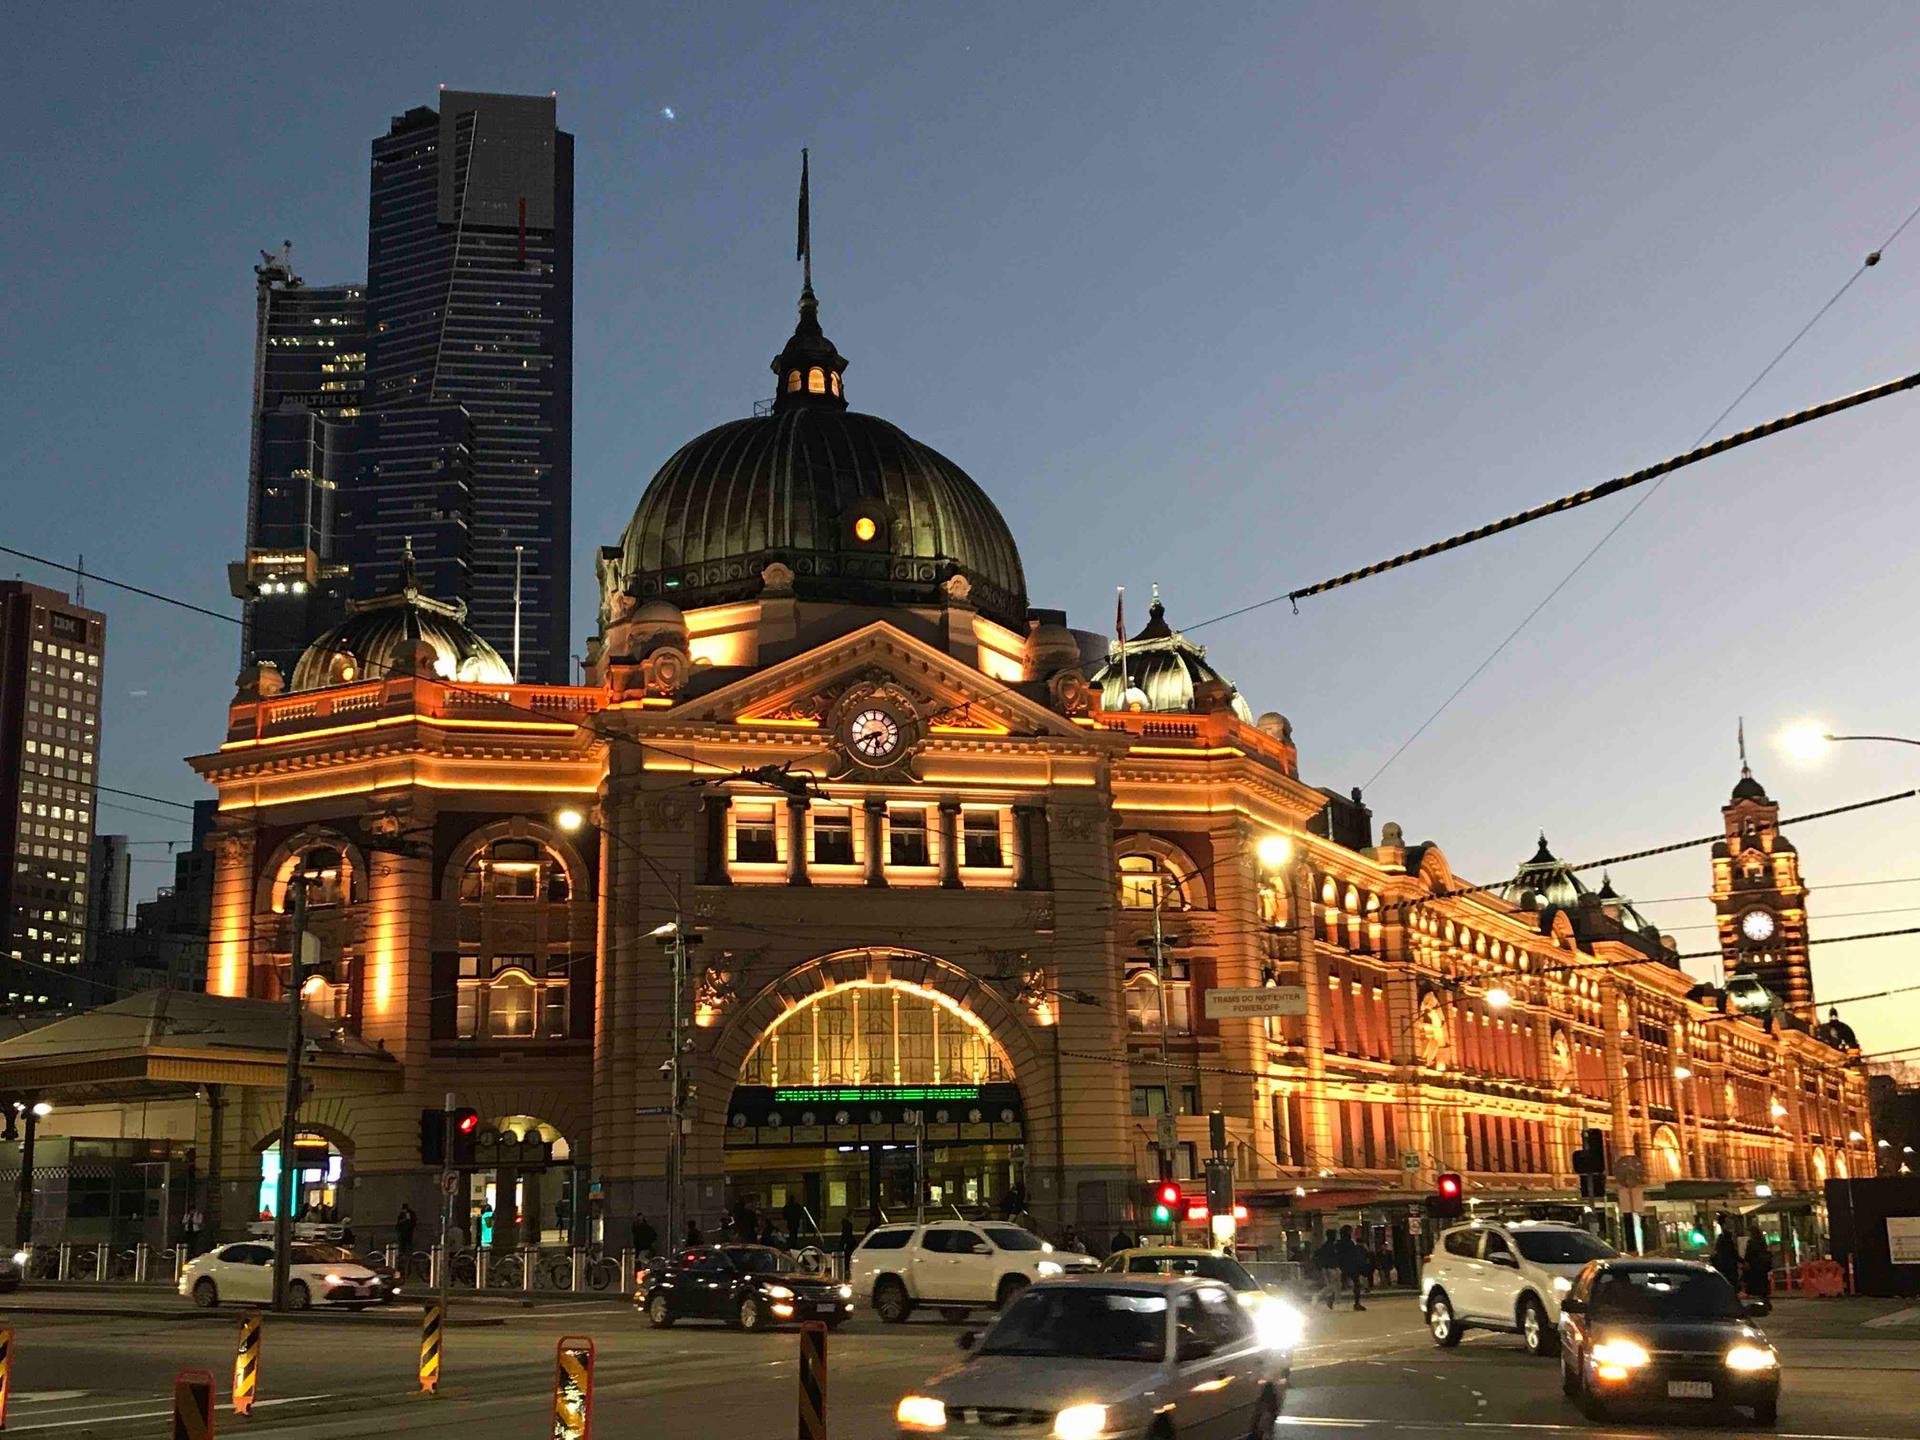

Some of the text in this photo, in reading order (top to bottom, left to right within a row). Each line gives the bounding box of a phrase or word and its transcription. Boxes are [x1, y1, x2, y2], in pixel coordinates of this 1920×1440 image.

[281, 394, 358, 406] MULTIPLEX
[54, 616, 74, 632] IBM
[1213, 996, 1240, 1004] TRAMS
[1255, 994, 1271, 1002] NOT
[1273, 993, 1300, 1001] ENTER
[1233, 1004, 1262, 1012] POWER
